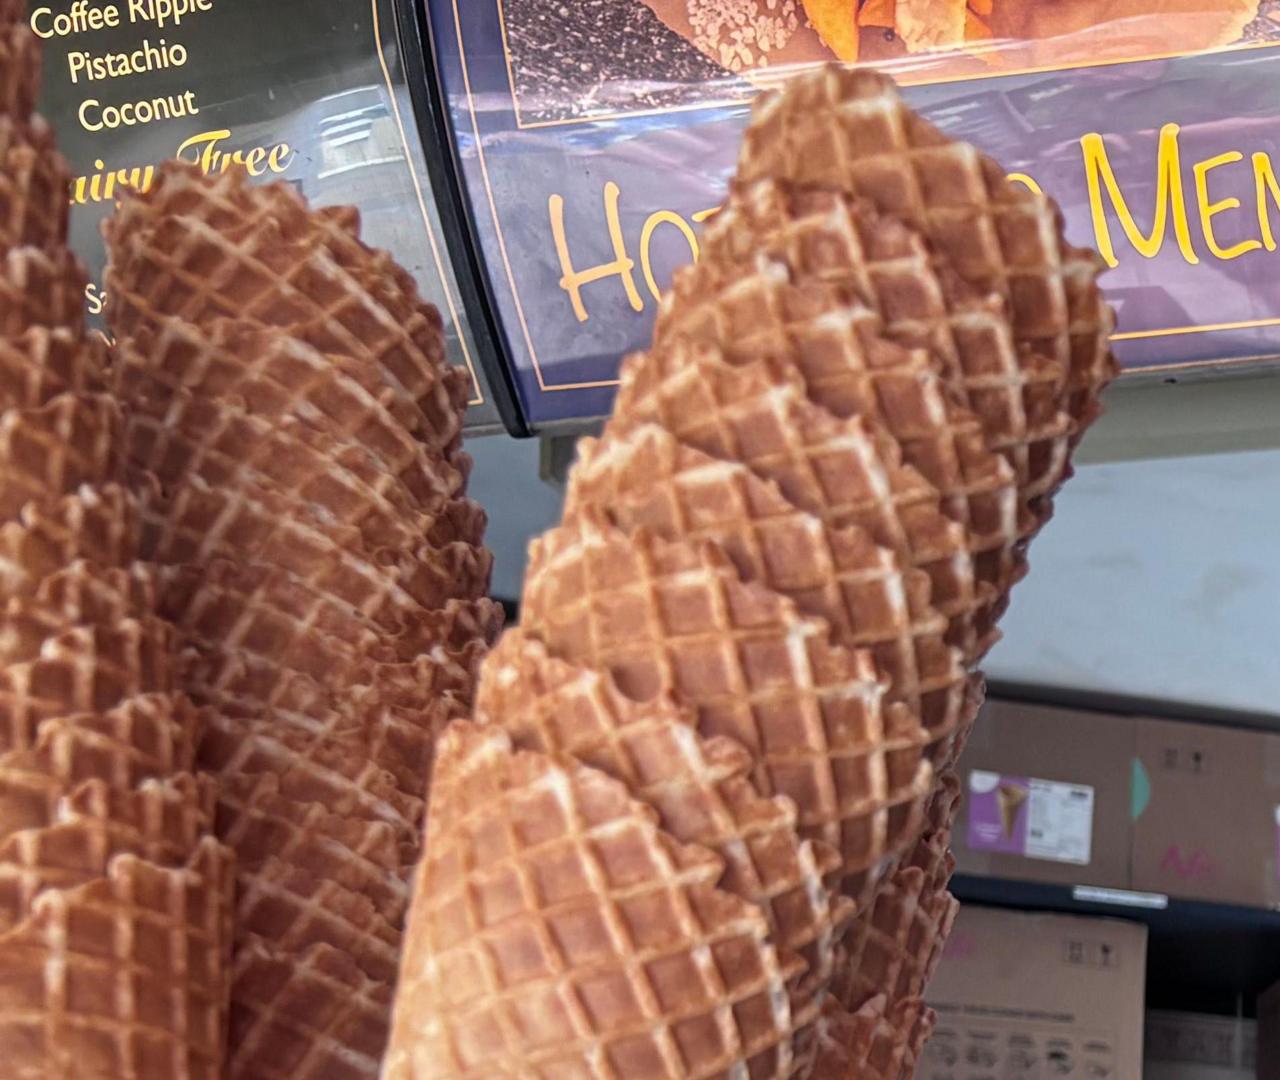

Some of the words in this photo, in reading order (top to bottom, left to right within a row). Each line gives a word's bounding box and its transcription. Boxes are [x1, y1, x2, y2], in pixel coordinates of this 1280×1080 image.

[30, 0, 119, 38] Coffee
[67, 38, 188, 84] Pistachio
[78, 90, 200, 132] Coconut
[69, 158, 155, 210] airy
[176, 129, 298, 177] Free
